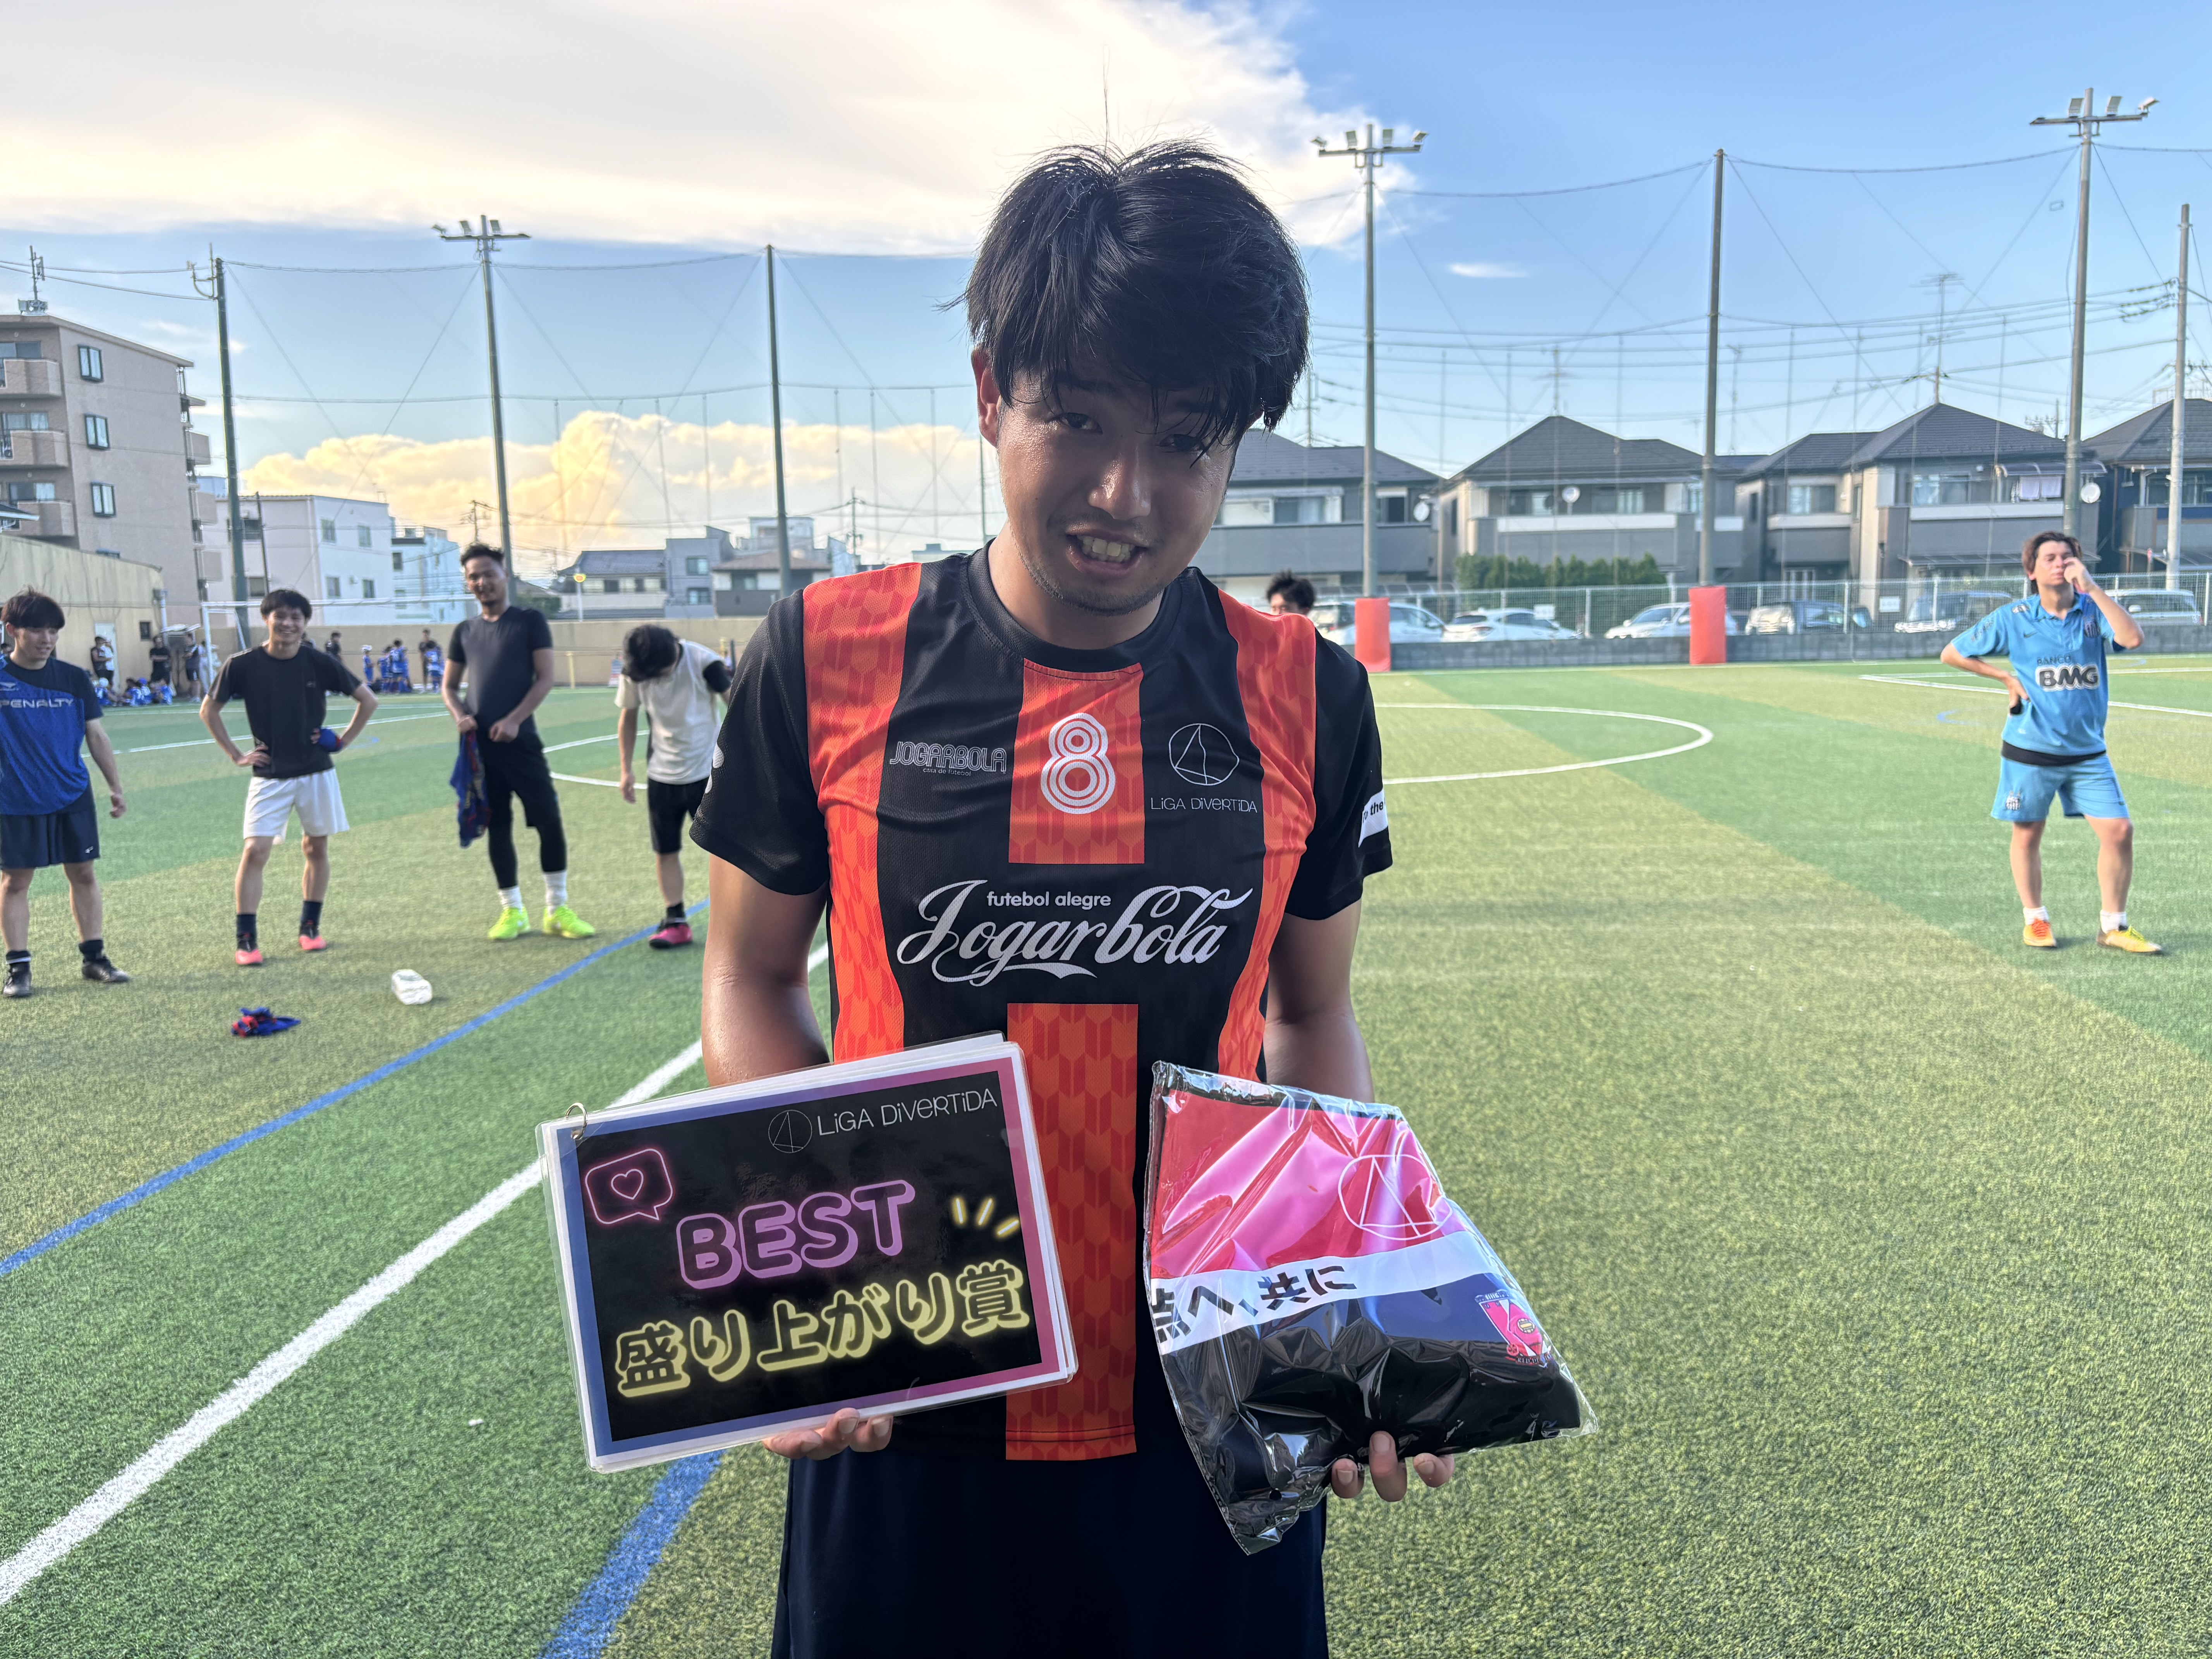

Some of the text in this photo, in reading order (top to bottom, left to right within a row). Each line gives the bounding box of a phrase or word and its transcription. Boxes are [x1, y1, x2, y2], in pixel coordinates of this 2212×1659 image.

[2039, 666, 2099, 687] BMG
[0, 698, 74, 708] PENALTY
[889, 741, 1007, 773] JOGARBOLA
[1040, 712, 1116, 815] 8
[1370, 801, 1384, 816] the
[986, 891, 1111, 910] futebol alegre
[896, 879, 1253, 987] Jogarbola
[676, 1180, 915, 1289] BEST
[615, 1259, 1030, 1397] 盛り上がり賞
